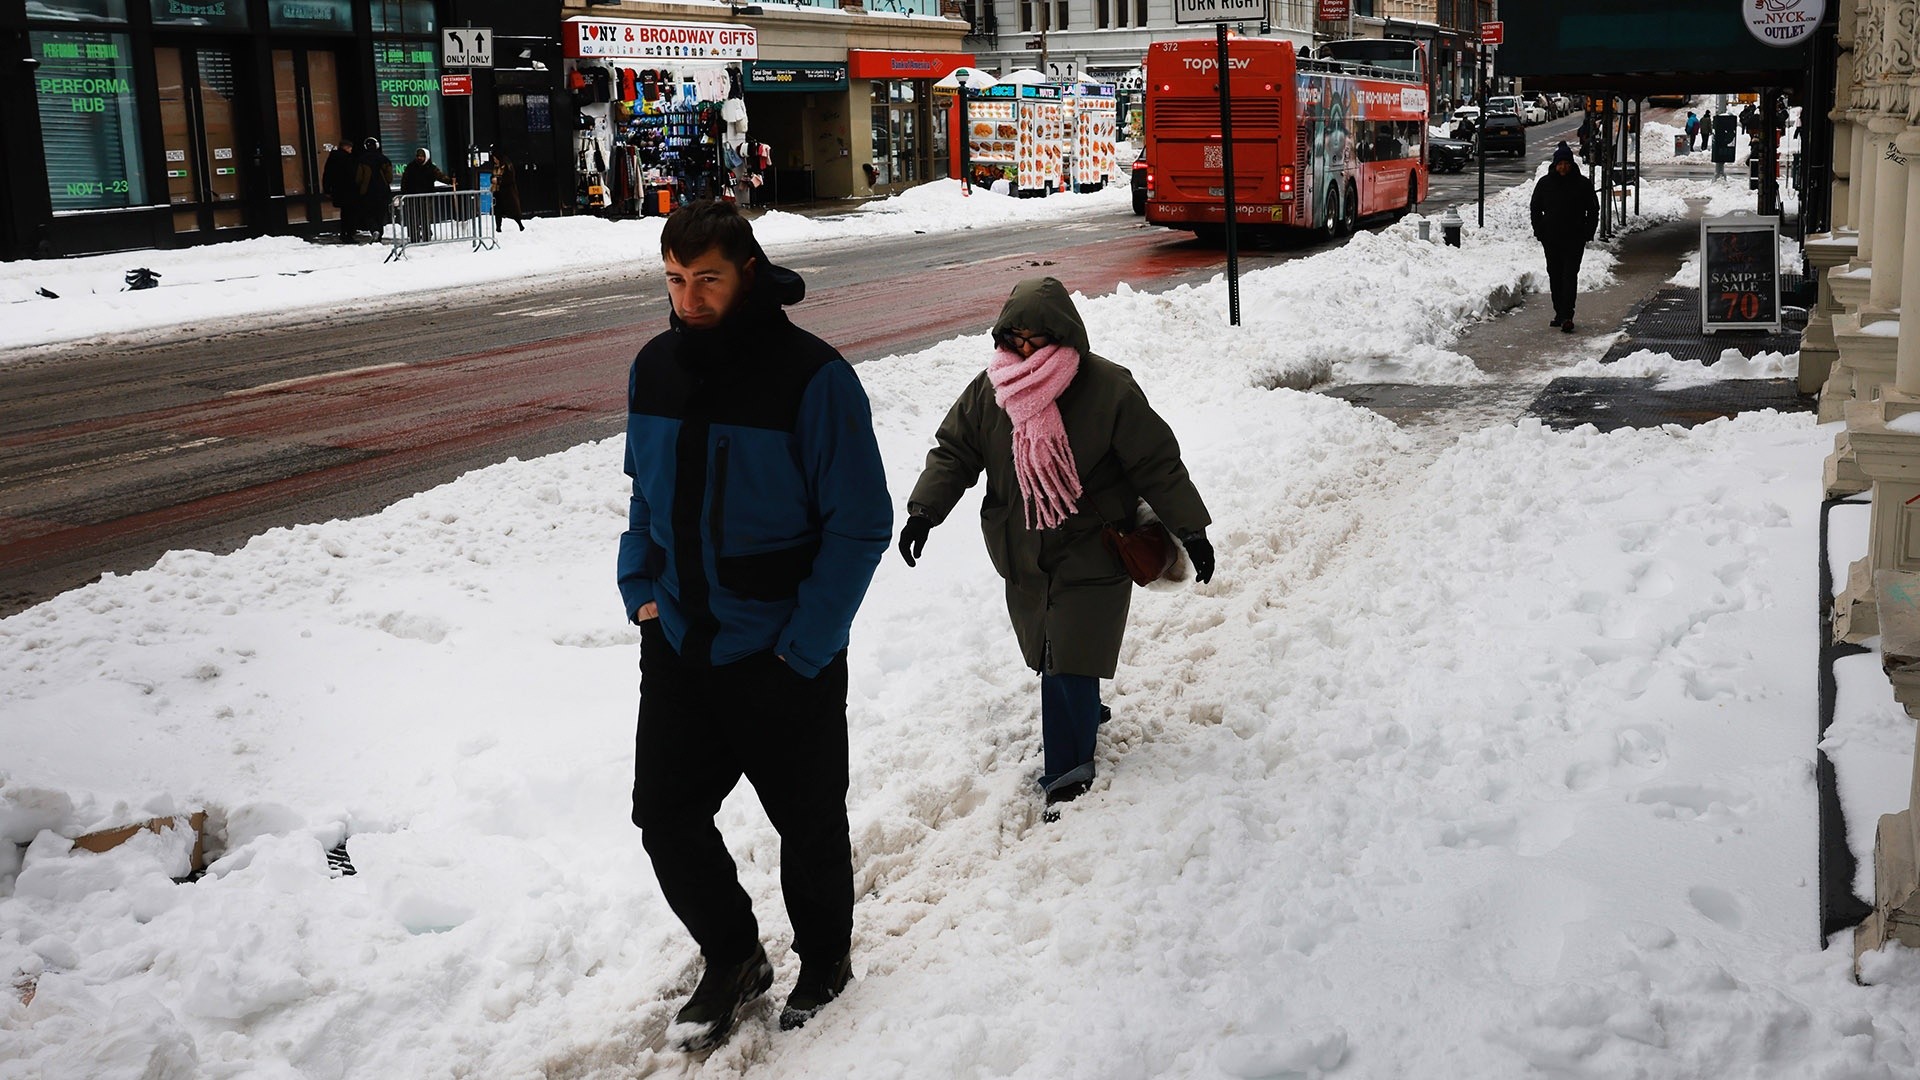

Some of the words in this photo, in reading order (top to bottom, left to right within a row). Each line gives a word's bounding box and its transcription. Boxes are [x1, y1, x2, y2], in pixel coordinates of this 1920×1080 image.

[1221, 0, 1260, 9] RIGHT
[624, 27, 634, 42] &
[640, 27, 714, 44] BROADWAY
[719, 31, 755, 46] GIFTS
[1764, 25, 1805, 39] OUTLET
[1163, 43, 1178, 52] 372
[446, 55, 465, 63] ONLY
[470, 55, 489, 63] ONLY
[1183, 58, 1251, 75] TOPVEW
[40, 79, 130, 94] PERFORMA
[381, 80, 440, 92] PERFORMA
[991, 85, 1015, 97] RICE
[71, 98, 105, 112] HUB
[391, 94, 430, 107] STUDIO
[66, 182, 94, 197] NOV
[1711, 272, 1772, 283] SAMPLE
[1721, 281, 1760, 292] SALE
